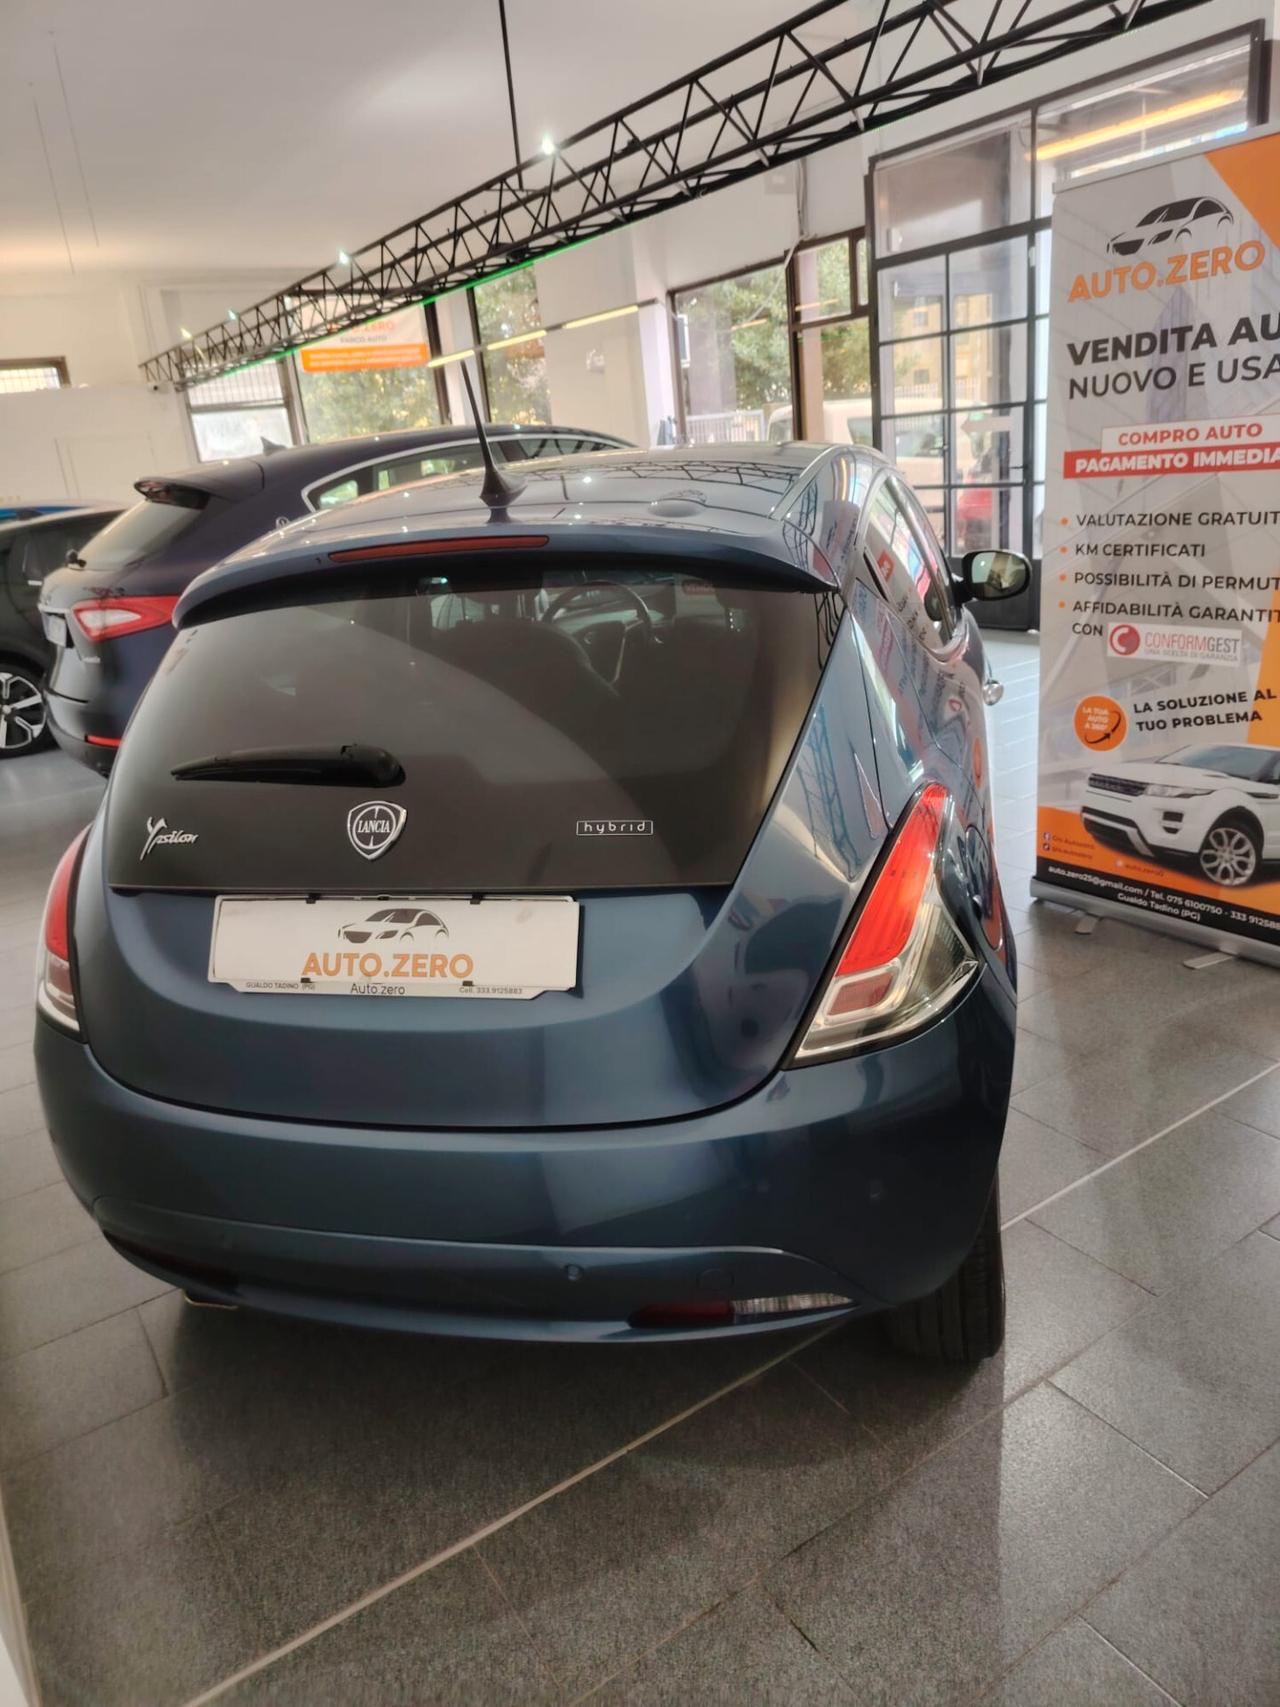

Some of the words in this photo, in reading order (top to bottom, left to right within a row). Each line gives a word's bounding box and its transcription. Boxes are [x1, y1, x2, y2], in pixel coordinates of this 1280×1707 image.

[1068, 240, 1265, 303] AUTO.ZERO
[1067, 323, 1217, 366] VENDITA
[1227, 312, 1280, 345] AU
[1069, 366, 1177, 400] NUOVO
[1188, 363, 1205, 386] E
[1217, 353, 1280, 383] USA
[1118, 427, 1199, 446] COMPRO
[1205, 423, 1263, 440] AUTO
[1075, 453, 1189, 473] PAGAMENTO
[1193, 447, 1280, 467] IMMEDIA
[1076, 512, 1192, 527] VALUTAZIONE
[1198, 511, 1280, 526] GRATUIT
[1075, 544, 1098, 556] KM
[1102, 544, 1205, 557] CERTIFICATI
[1074, 571, 1173, 588] POSSIBILITÀ
[1178, 575, 1196, 588] DI
[1073, 601, 1184, 618] AFFIDABILITÀ
[1072, 622, 1103, 636] CON
[1144, 632, 1240, 654] CONFORMGEST
[1134, 703, 1153, 714] LA
[1157, 692, 1248, 711] SOLUZIONE
[1254, 689, 1277, 701] AL
[1136, 720, 1167, 732] TUO
[1172, 710, 1263, 728] PROBLEMA
[357, 820, 391, 834] LANCIA
[584, 821, 645, 834] hybrid
[140, 817, 199, 861] Ypsilon
[1048, 866, 1143, 896] auto.zero25@gmail.com
[1150, 890, 1165, 900] Tel.
[1166, 894, 1183, 906] 075
[1184, 898, 1223, 916] 6100750
[1230, 910, 1247, 922] 333
[1117, 892, 1149, 907] Gualdo
[1150, 901, 1180, 915] Tadino
[1181, 908, 1201, 922] (PG)
[301, 952, 475, 979] AUTO.ZERO
[246, 982, 273, 990] GUALDO
